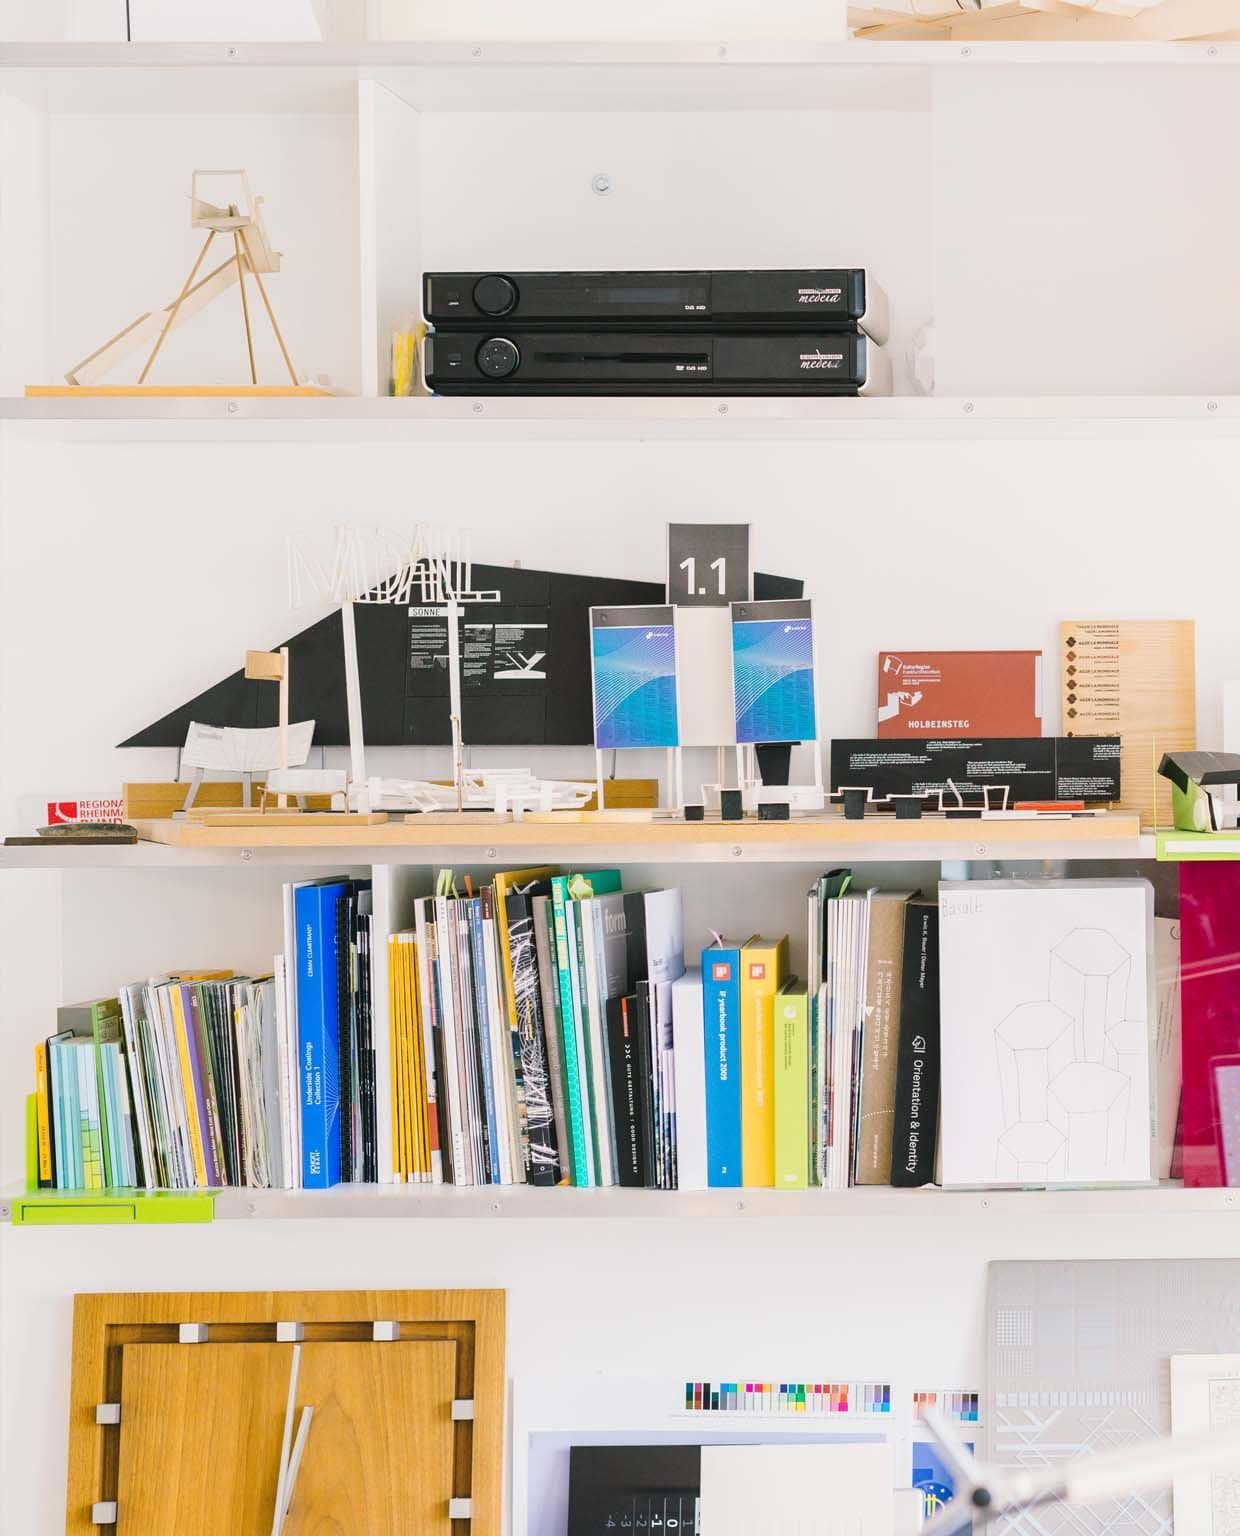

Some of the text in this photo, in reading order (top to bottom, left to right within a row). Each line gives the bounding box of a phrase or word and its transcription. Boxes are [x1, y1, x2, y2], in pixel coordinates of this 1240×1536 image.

[680, 557, 726, 595] 1.1
[413, 608, 440, 616] SONNE
[908, 719, 970, 729] HOLBEINSTEG
[80, 809, 123, 818] RHEINM
[605, 907, 626, 933] form
[718, 998, 728, 1032] yearbook
[305, 1041, 313, 1071] Coatings
[718, 1034, 728, 1062] product
[719, 1063, 728, 1081] 2009
[906, 1059, 923, 1173] Orientation & Identity
[651, 1513, 662, 1528] -1
[666, 1519, 678, 1528] 0
